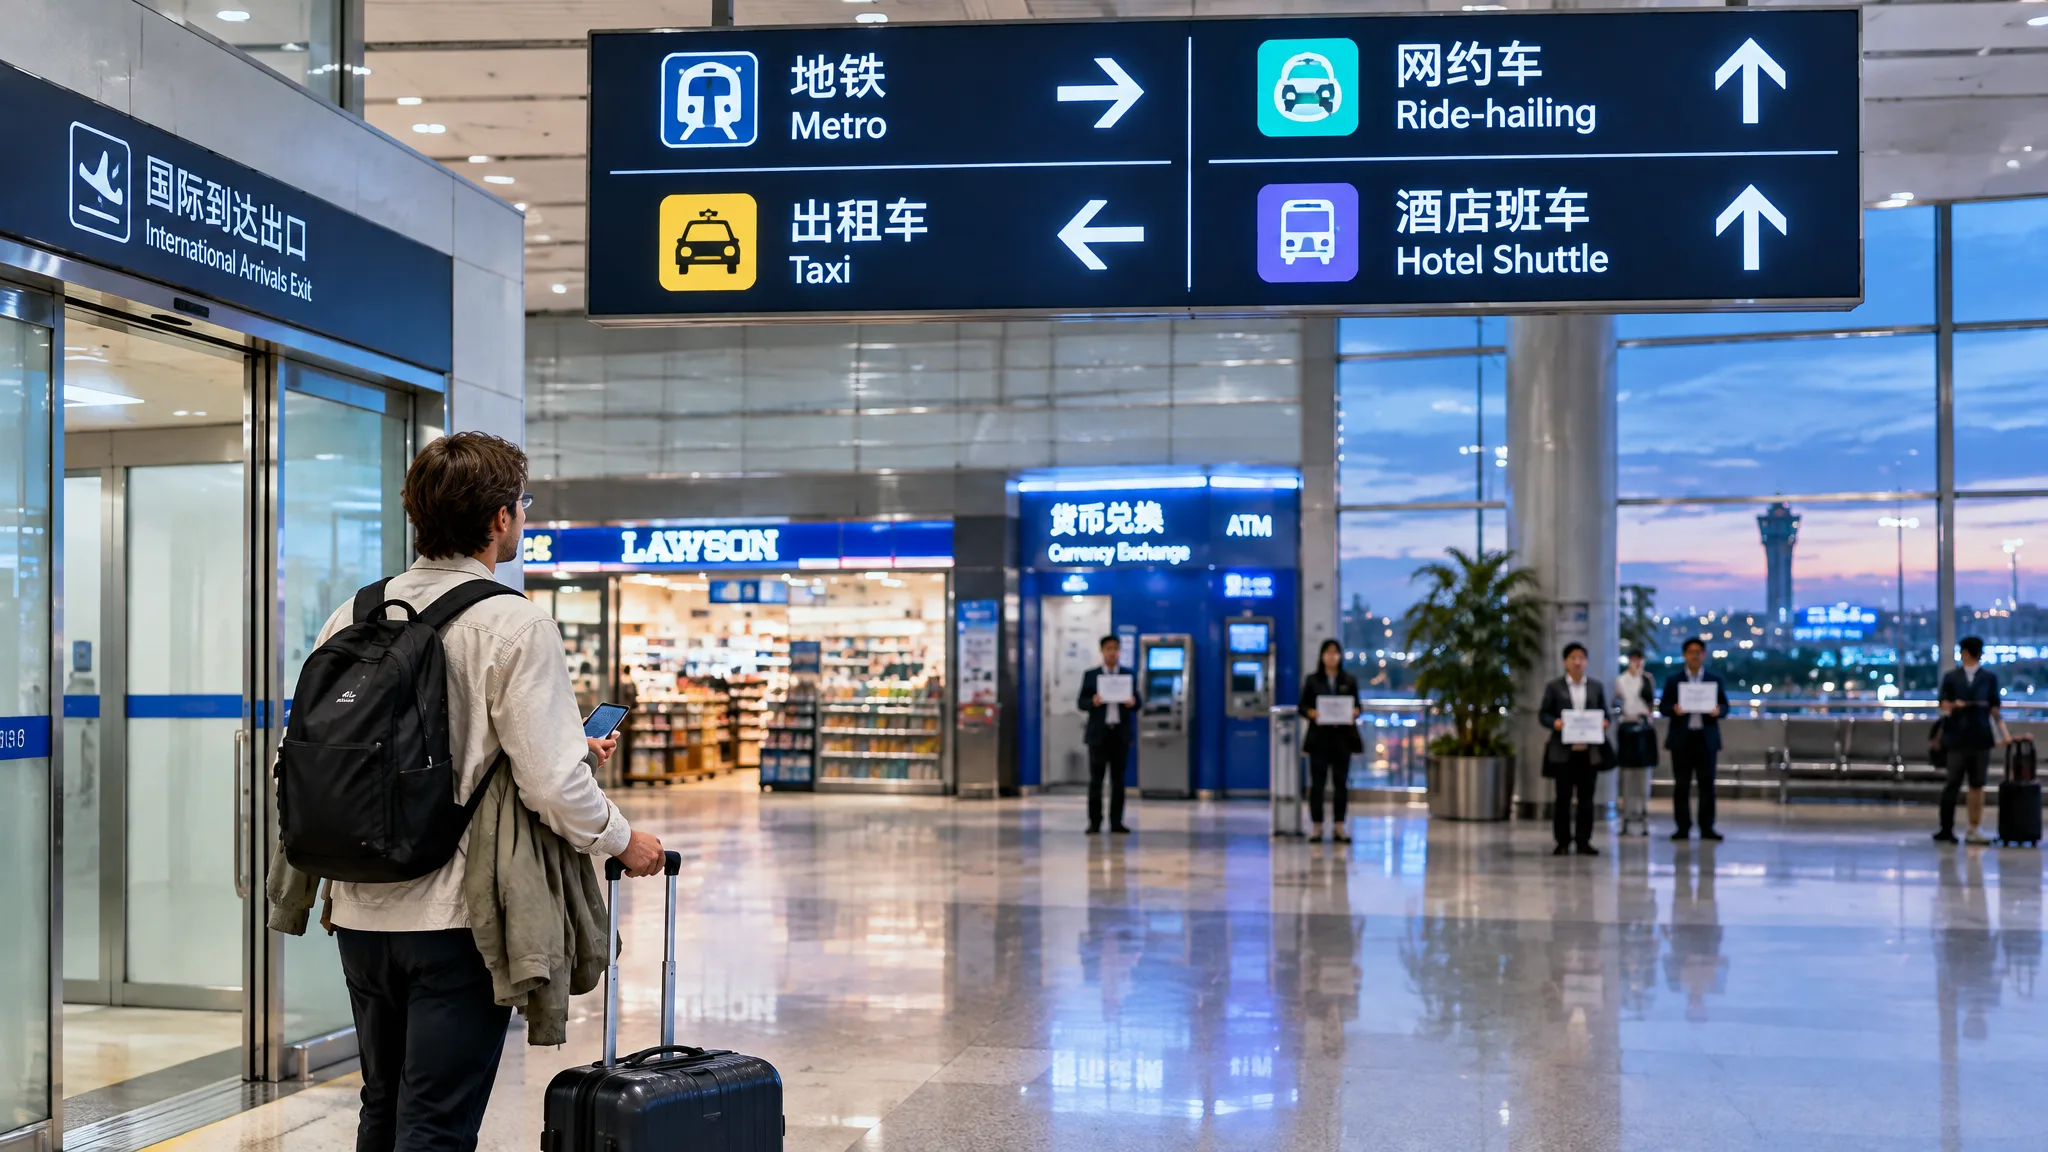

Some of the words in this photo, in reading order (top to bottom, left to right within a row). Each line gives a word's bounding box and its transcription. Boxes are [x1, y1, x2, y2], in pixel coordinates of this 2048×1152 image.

[790, 52, 886, 99] 地铁
[1397, 40, 1543, 88] 网约车
[791, 111, 887, 140] Metro
[1397, 97, 1596, 135] Ride-hailing
[146, 154, 306, 262] 国际到达出口
[791, 196, 928, 243] 出租车
[1396, 186, 1590, 234] 酒店班车
[146, 218, 236, 275] International
[239, 253, 288, 293] Arrivals
[290, 271, 313, 302] Exit
[788, 254, 851, 284] Taxi
[1397, 243, 1483, 276] Hotel
[1493, 242, 1609, 275] Shuttle
[1049, 500, 1165, 537] 货币兑换
[1225, 514, 1273, 538] ATM
[621, 528, 779, 563] LAWSON
[1048, 542, 1116, 567] Currency
[1116, 541, 1191, 565] Exchange
